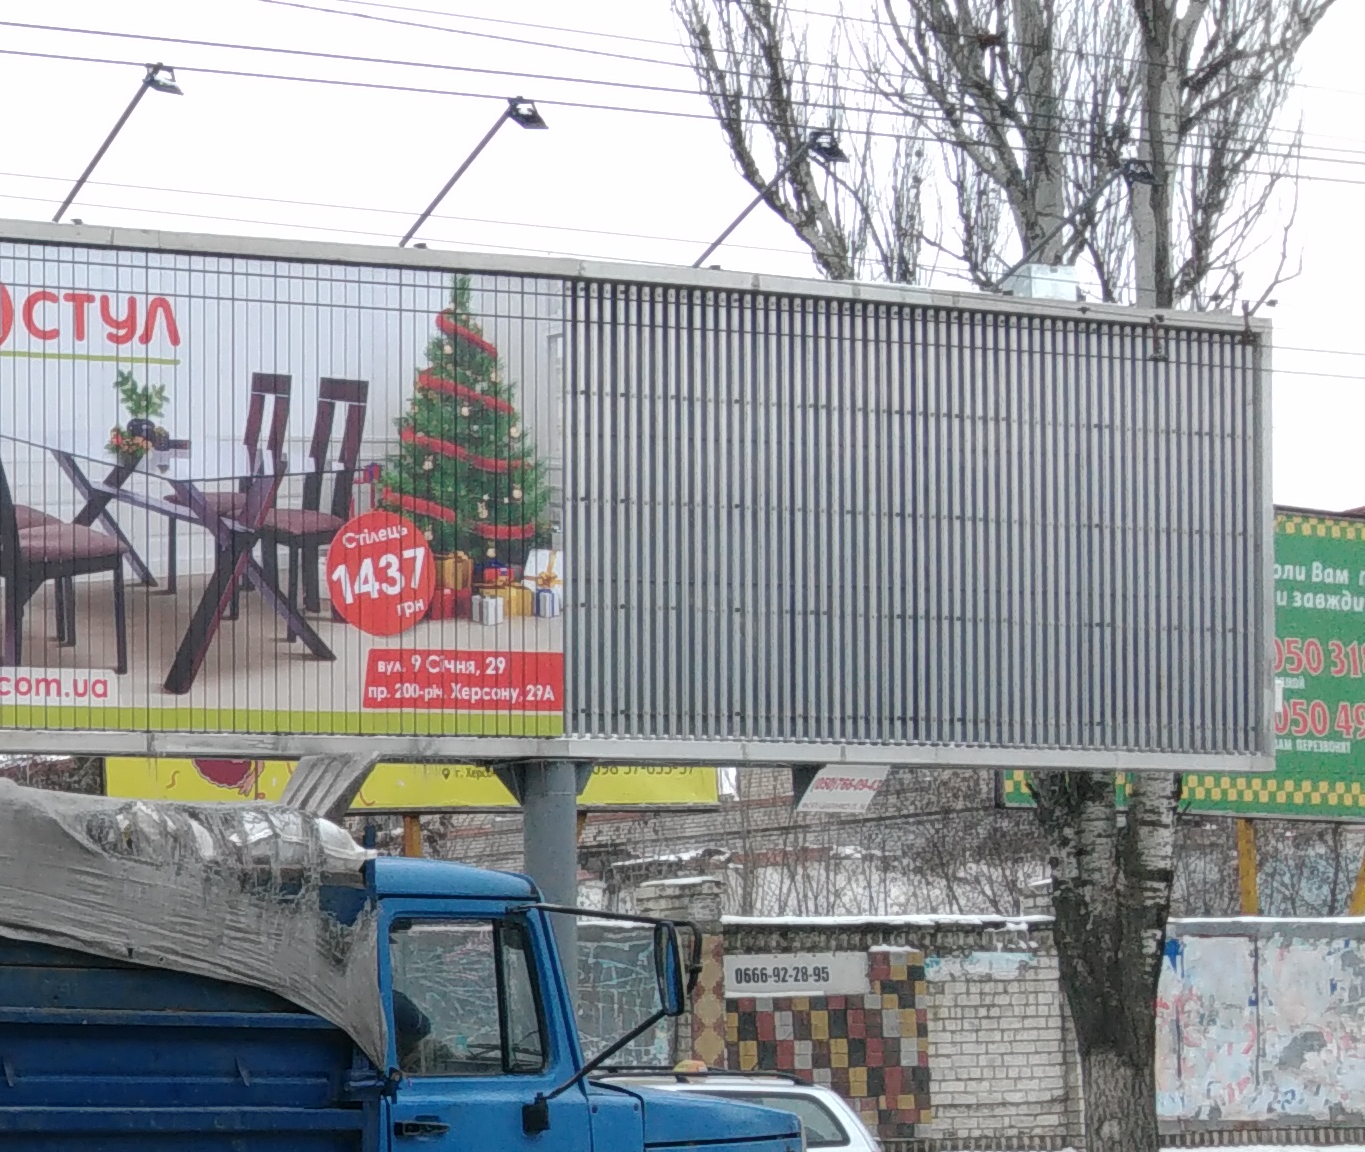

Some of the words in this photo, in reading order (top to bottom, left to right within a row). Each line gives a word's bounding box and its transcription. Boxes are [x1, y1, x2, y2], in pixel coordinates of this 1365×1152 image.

[22, 290, 181, 347] СТУЛ
[342, 525, 408, 548] Стілець
[331, 546, 426, 605] 1437
[1311, 561, 1349, 584] Вам
[396, 598, 425, 618] грн
[1292, 590, 1365, 612] завжди
[377, 660, 406, 676] вул.
[411, 655, 421, 672] 9
[426, 655, 480, 677] Січня,
[484, 656, 506, 675] 29
[368, 686, 390, 702] пр.
[525, 684, 555, 702] 29А
[734, 966, 830, 984] 0666-92-28-95
